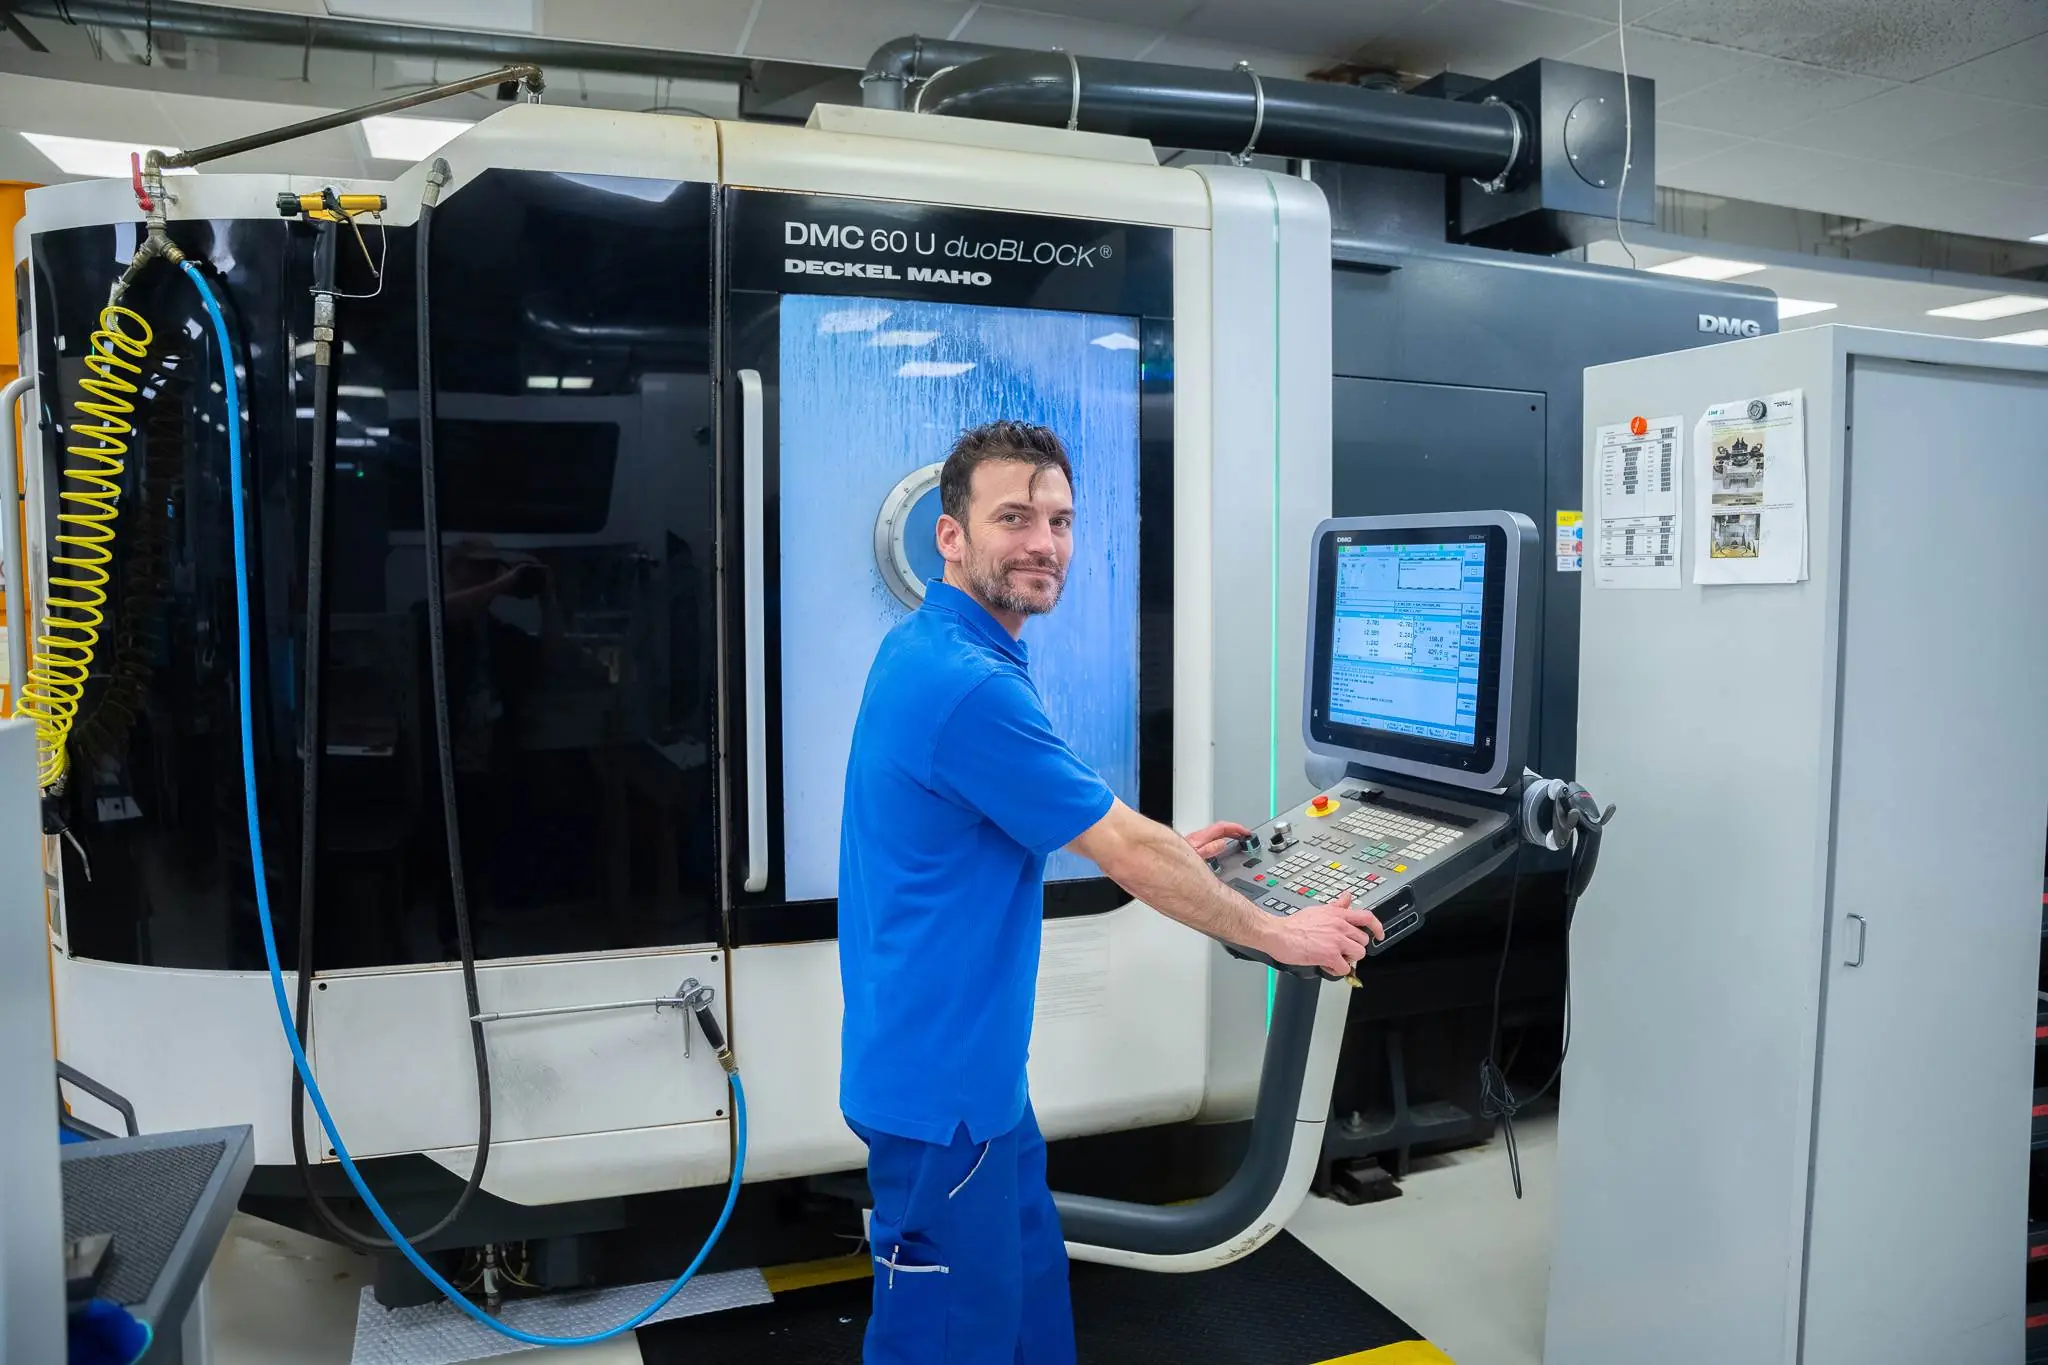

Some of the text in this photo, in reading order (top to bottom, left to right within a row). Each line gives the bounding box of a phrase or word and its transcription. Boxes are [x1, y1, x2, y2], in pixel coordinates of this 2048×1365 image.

[784, 221, 865, 249] DMC
[870, 228, 908, 253] 60
[915, 231, 936, 255] U
[784, 258, 993, 286] DECKEL MAHO
[1698, 313, 1761, 337] DMG
